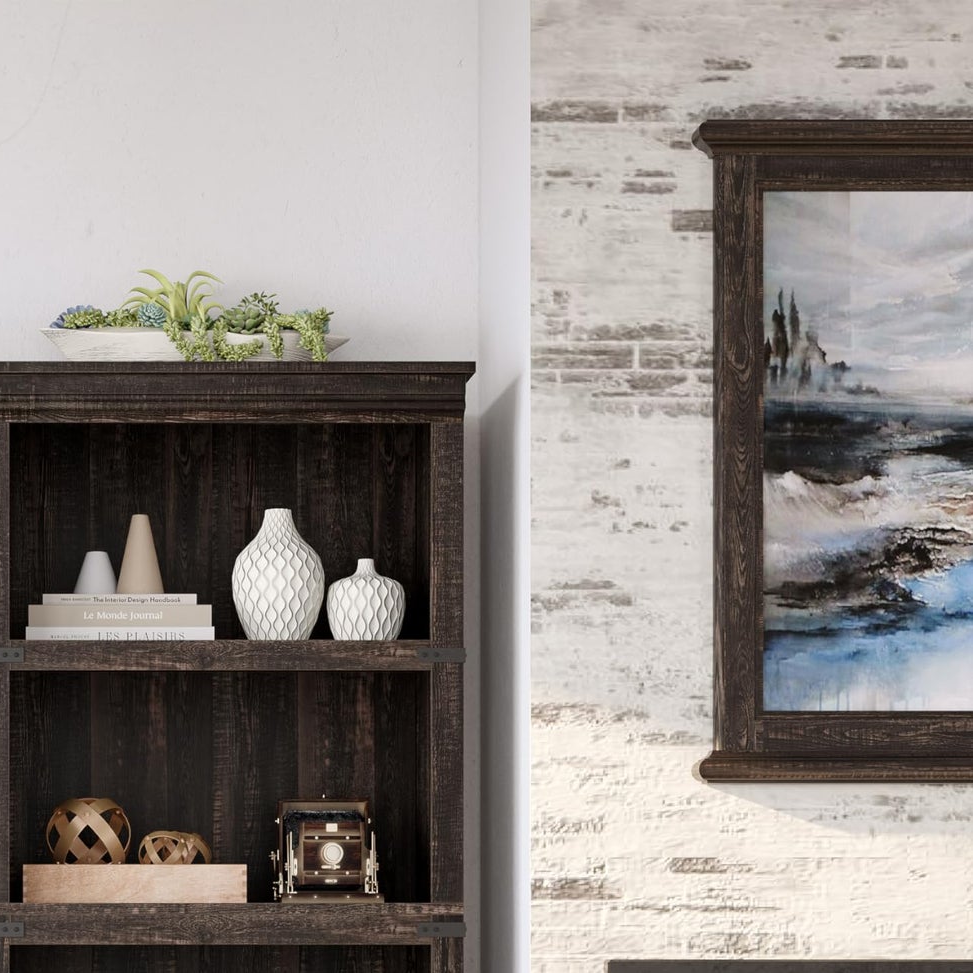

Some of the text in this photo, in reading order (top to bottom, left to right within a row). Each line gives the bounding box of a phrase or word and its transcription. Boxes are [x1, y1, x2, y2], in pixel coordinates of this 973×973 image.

[127, 597, 149, 605] Design
[84, 611, 163, 621] Le Monde Journal
[98, 632, 185, 641] LES PLAISIRS
